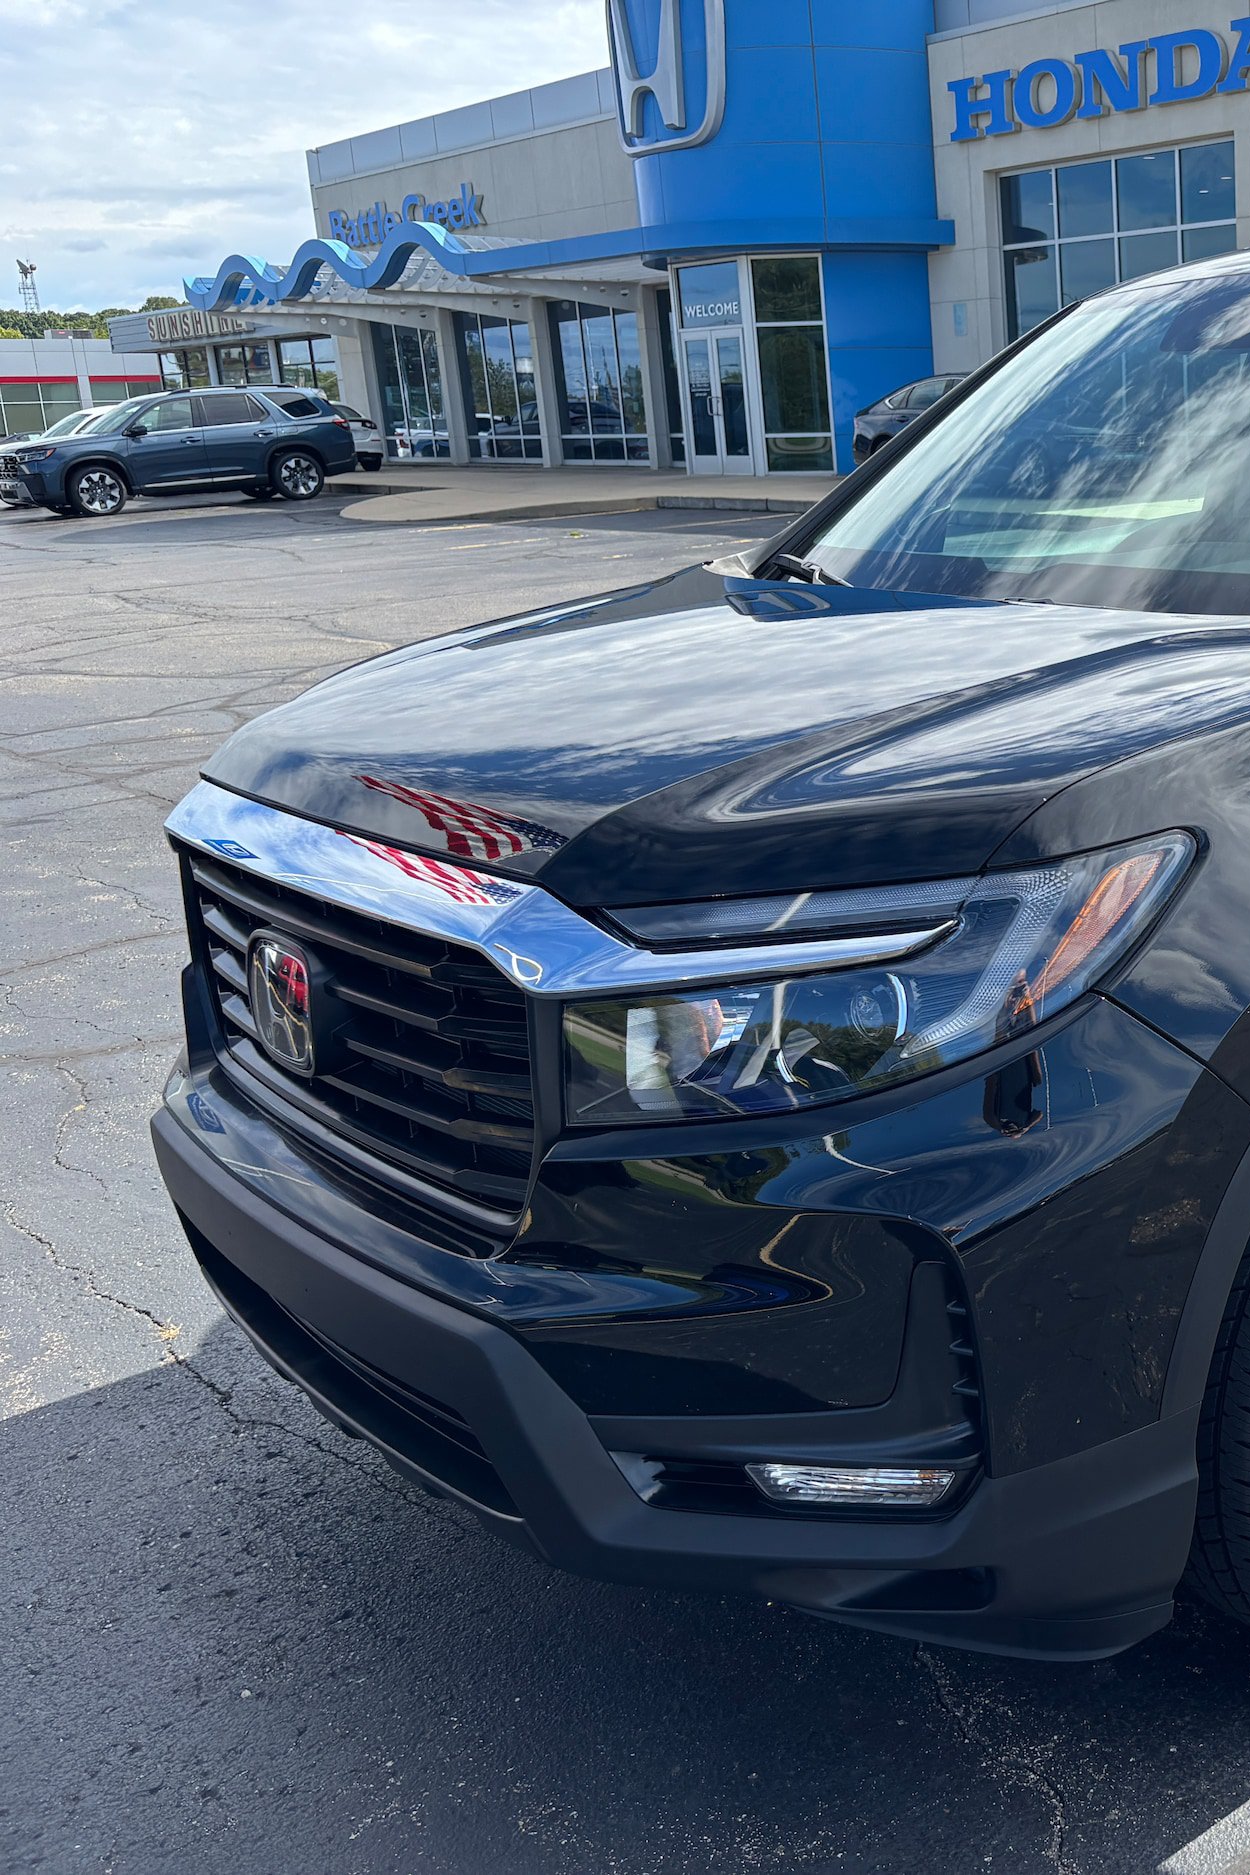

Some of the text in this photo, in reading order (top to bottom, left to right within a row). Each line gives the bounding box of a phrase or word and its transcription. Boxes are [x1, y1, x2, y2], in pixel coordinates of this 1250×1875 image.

[328, 182, 486, 247] Battle Creek
[685, 301, 740, 319] WELCOME
